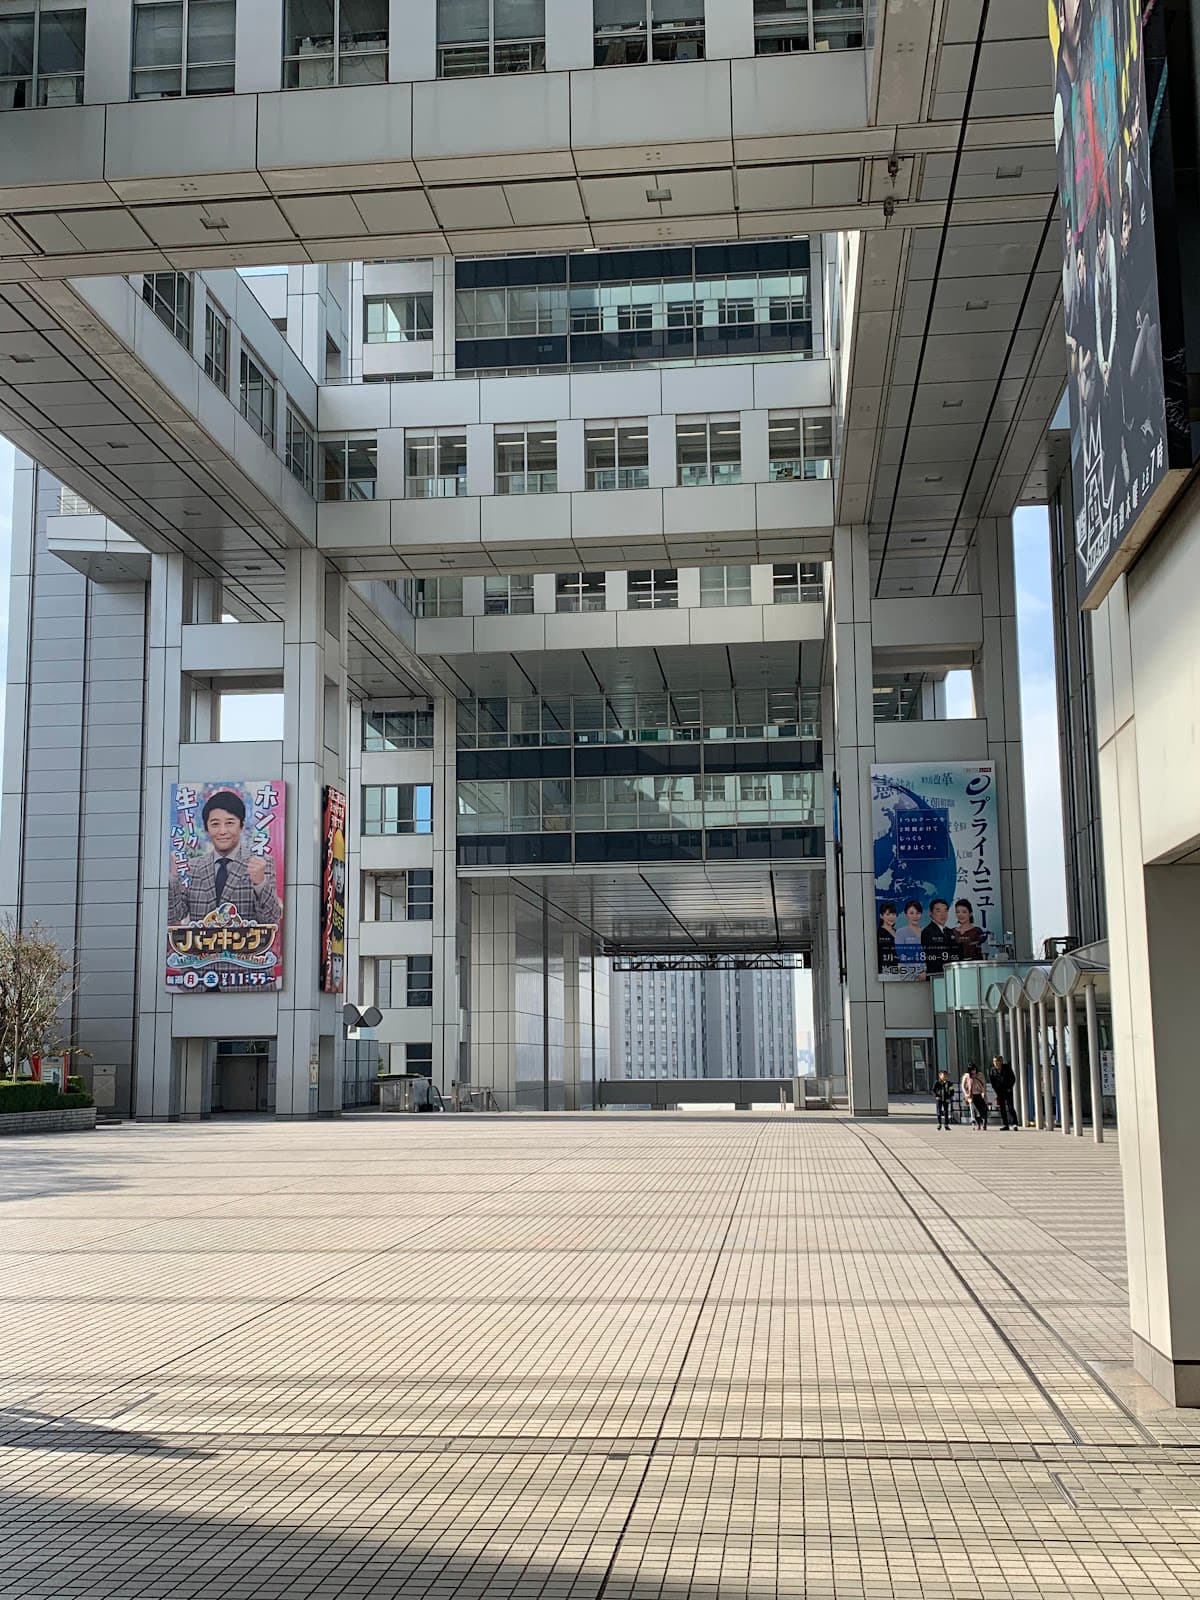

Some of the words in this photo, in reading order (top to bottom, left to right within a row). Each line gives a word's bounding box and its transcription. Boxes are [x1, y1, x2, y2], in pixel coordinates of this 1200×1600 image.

[175, 786, 199, 849] 生トーク
[252, 784, 279, 857] ホンネ
[171, 825, 192, 889] バラエティ
[177, 928, 267, 950] バイキング
